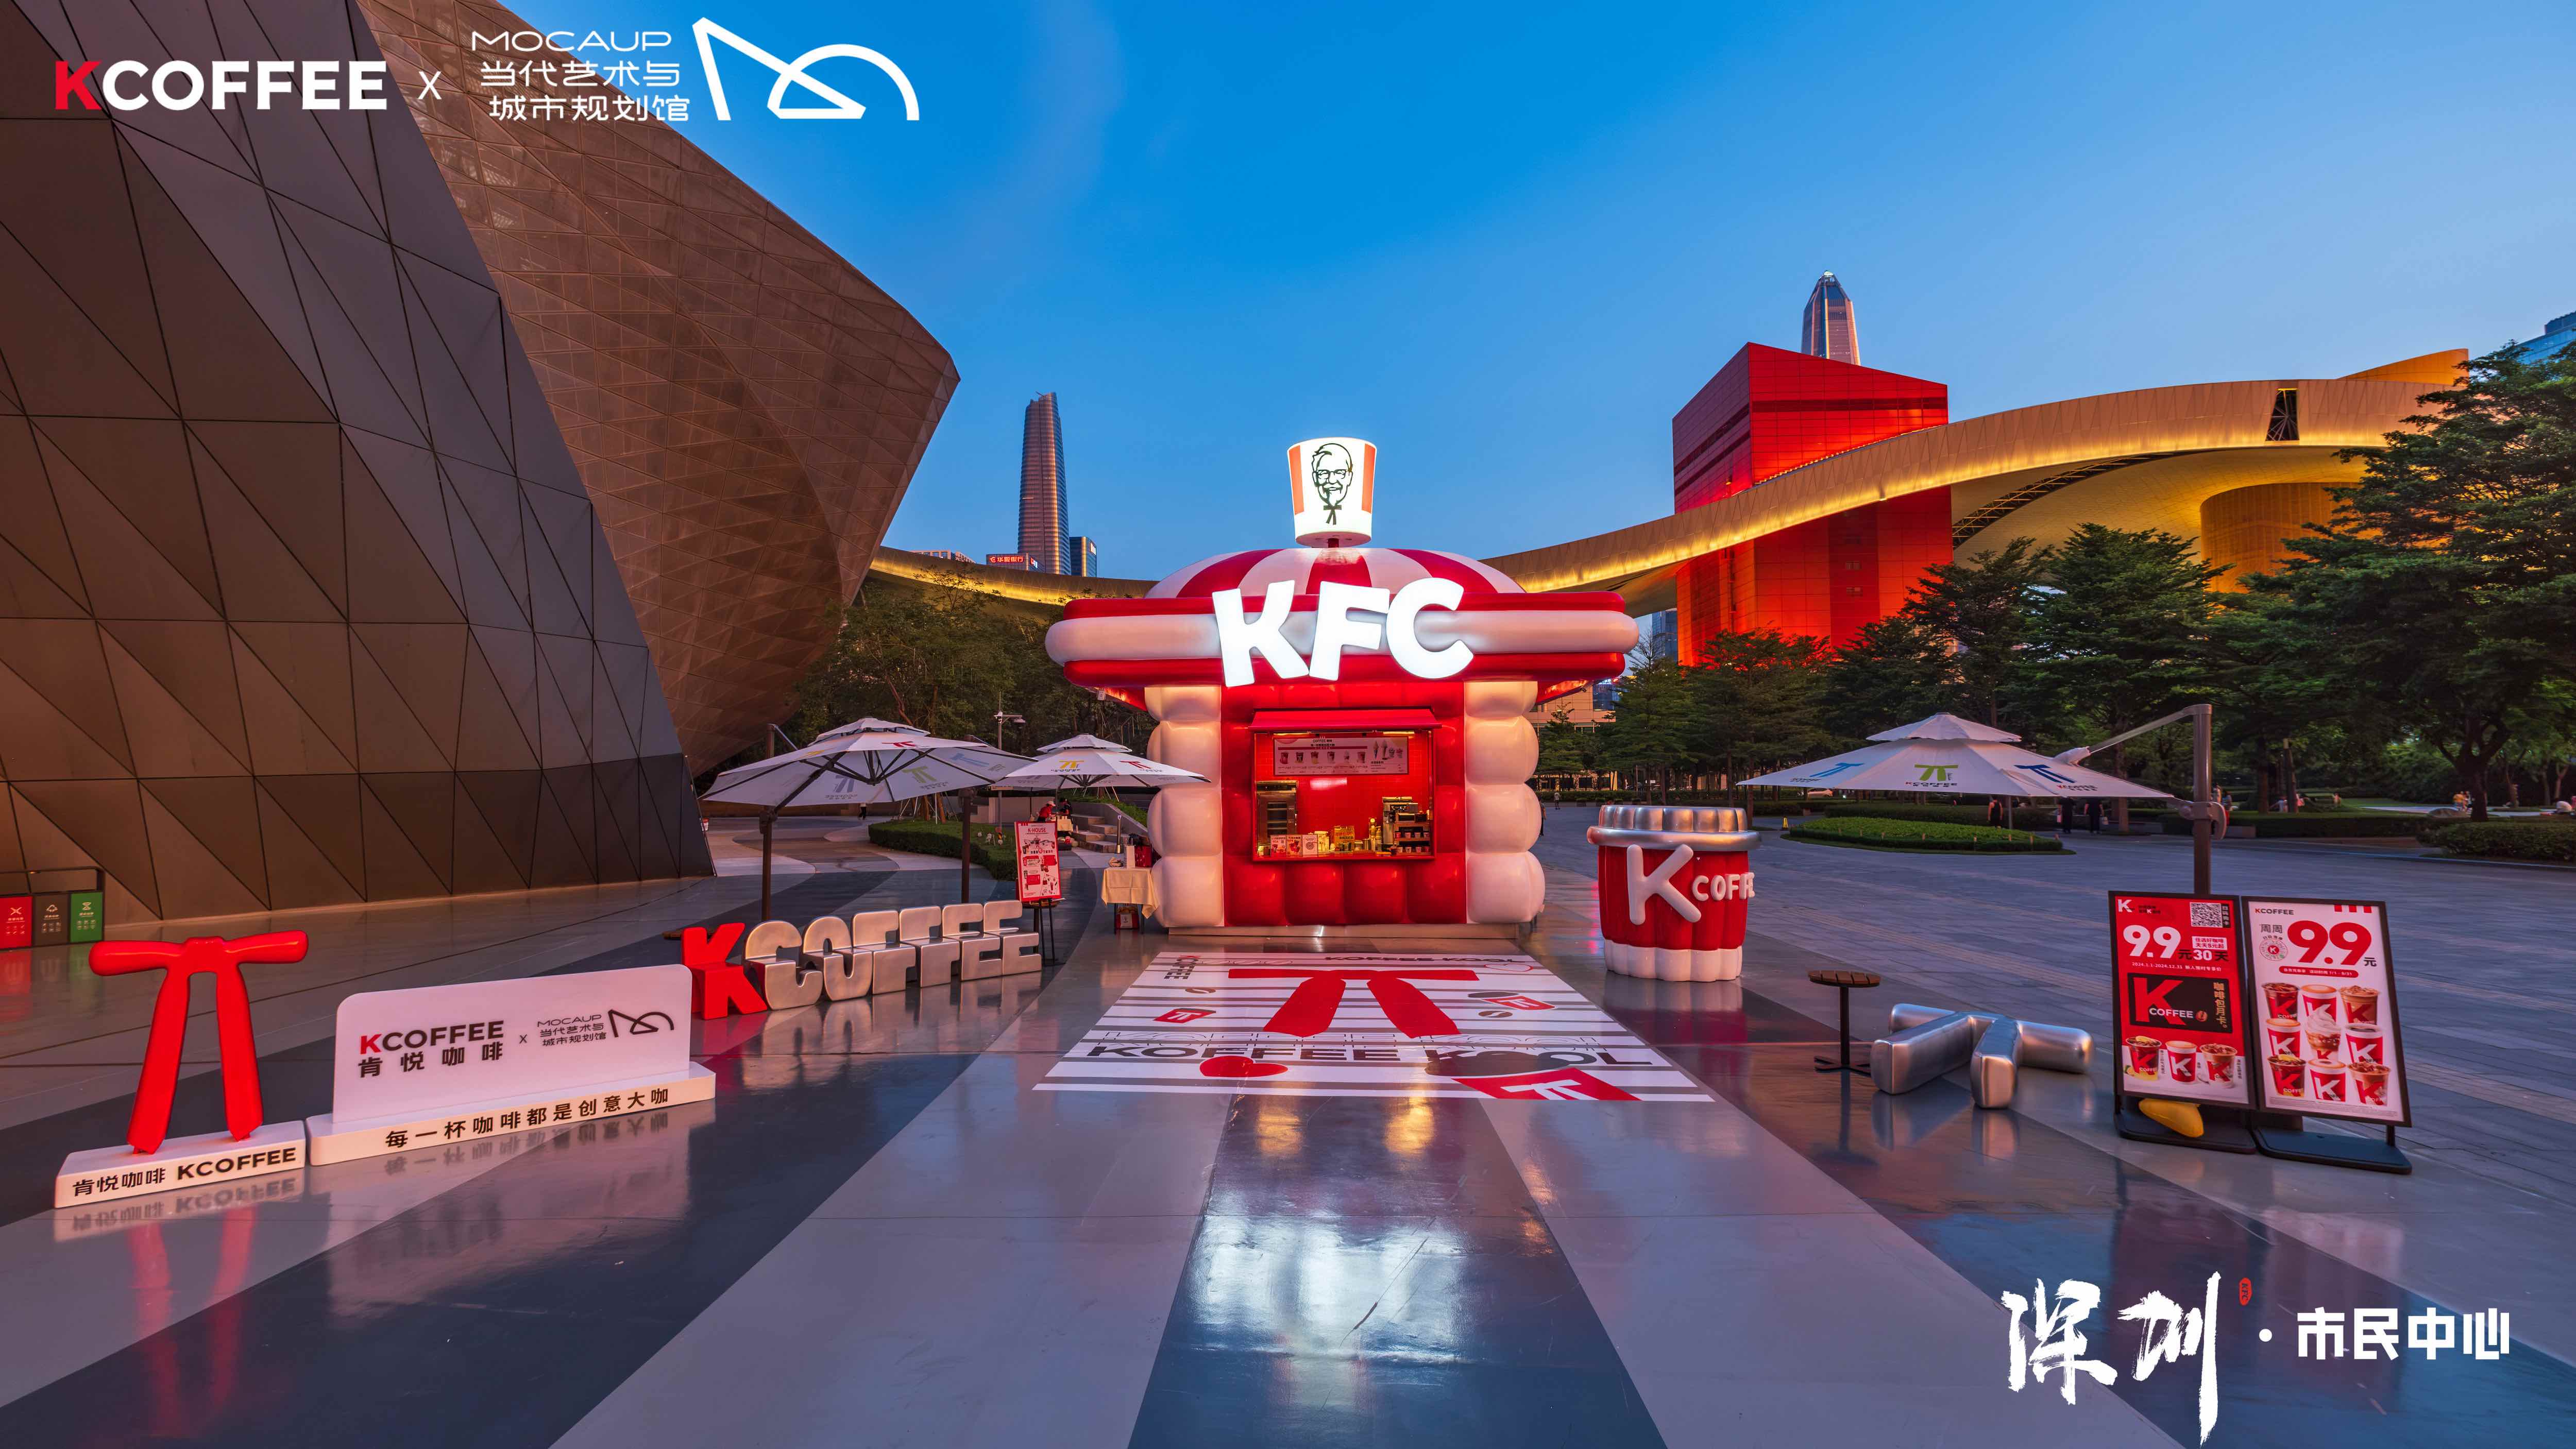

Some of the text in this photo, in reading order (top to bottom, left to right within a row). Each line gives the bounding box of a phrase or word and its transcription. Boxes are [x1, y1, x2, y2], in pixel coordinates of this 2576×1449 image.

[1212, 577, 1474, 687] KFC
[1626, 844, 1701, 925] K
[681, 900, 1042, 1020] KCOFFEE
[2123, 925, 2181, 959] 9.9
[2259, 924, 2283, 934] 周周
[2287, 920, 2372, 966] 9.9
[2364, 957, 2377, 967] 元
[537, 1014, 602, 1028] MOCAUP
[539, 1021, 604, 1037] 当代艺术与
[2149, 1008, 2193, 1019] COFFEE
[360, 1020, 504, 1055] KCOFFEE
[542, 1032, 607, 1047] 城市规划馆
[1087, 1046, 1401, 1061] KOFFEE
[358, 1041, 504, 1078] 肯悦咖啡
[385, 1088, 669, 1148] 每一杯咖啡都是创意大咖
[72, 1147, 297, 1198] 肯悦咖啡 KCOFFEE
